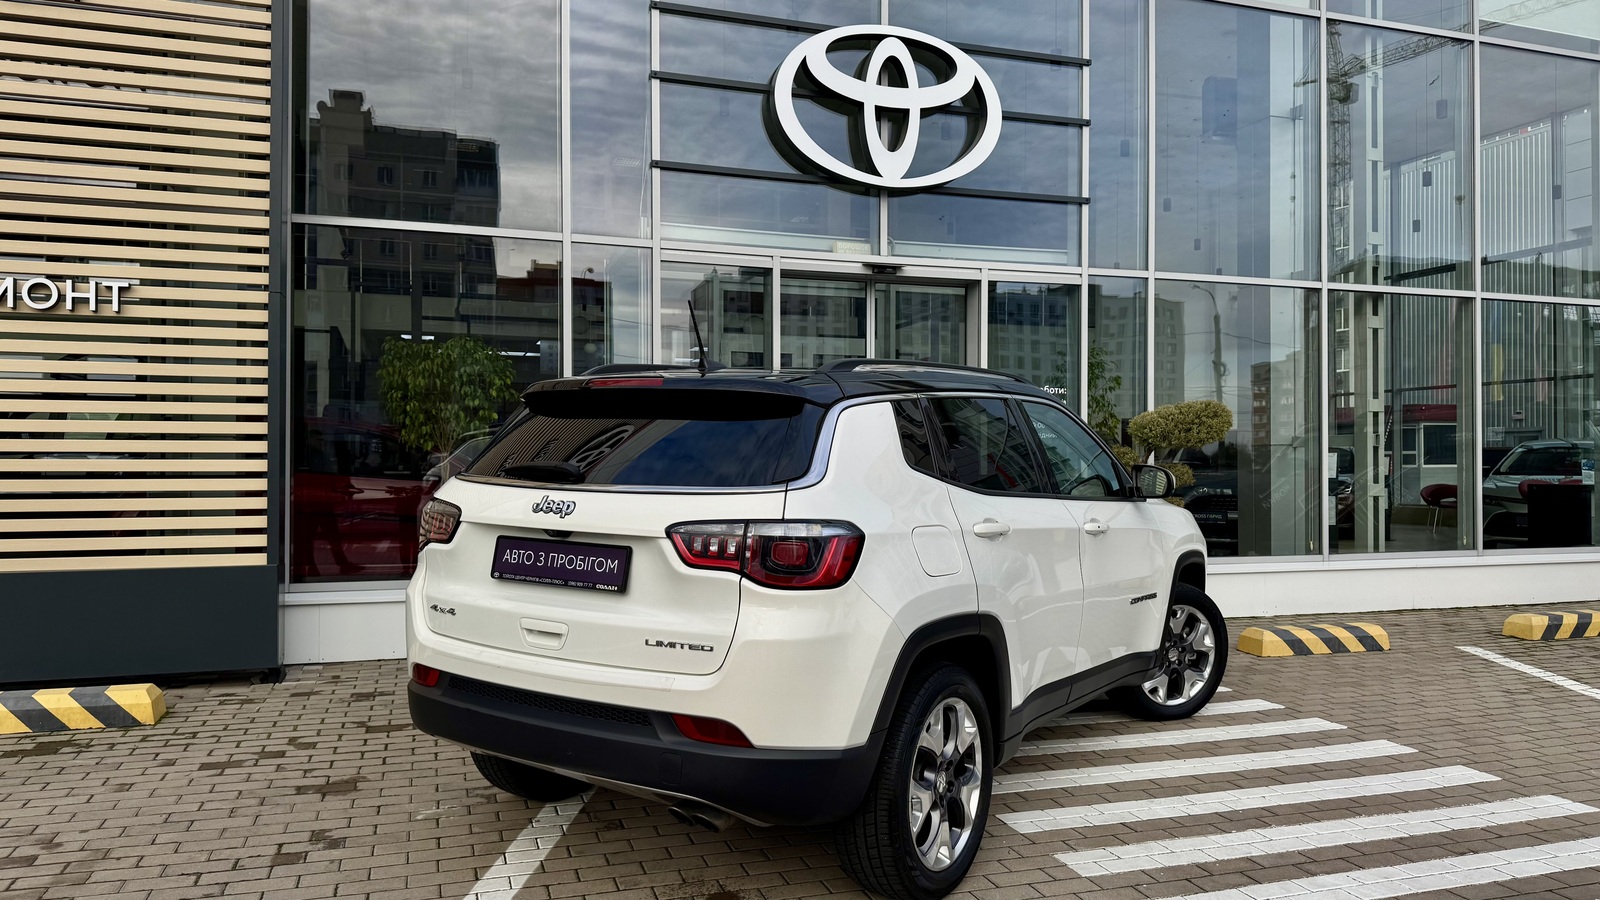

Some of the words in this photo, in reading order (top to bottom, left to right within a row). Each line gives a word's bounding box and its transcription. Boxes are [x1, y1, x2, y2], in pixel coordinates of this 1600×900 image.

[532, 494, 576, 519] Jeep
[502, 548, 535, 565] АВТО
[547, 553, 618, 573] ПРОБІГОМ
[645, 639, 714, 652] LIMITED
